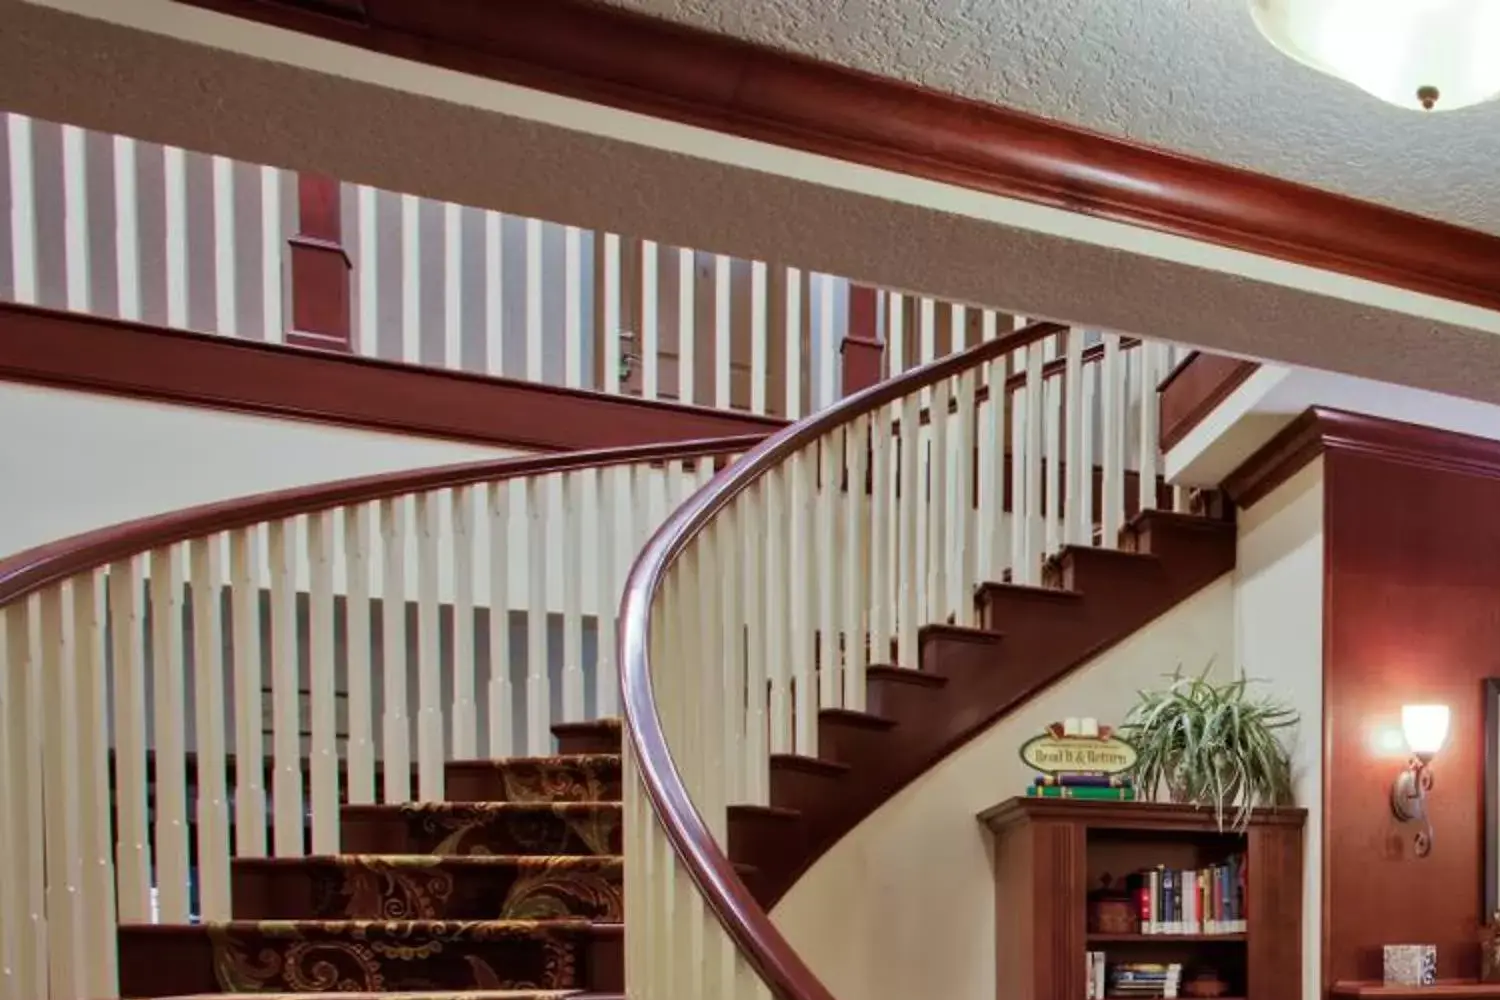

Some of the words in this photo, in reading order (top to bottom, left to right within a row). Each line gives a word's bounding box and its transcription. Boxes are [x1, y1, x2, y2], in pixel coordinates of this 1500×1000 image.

[1035, 749, 1062, 762] Read
[1077, 751, 1086, 763] &
[1087, 750, 1127, 764] Return
